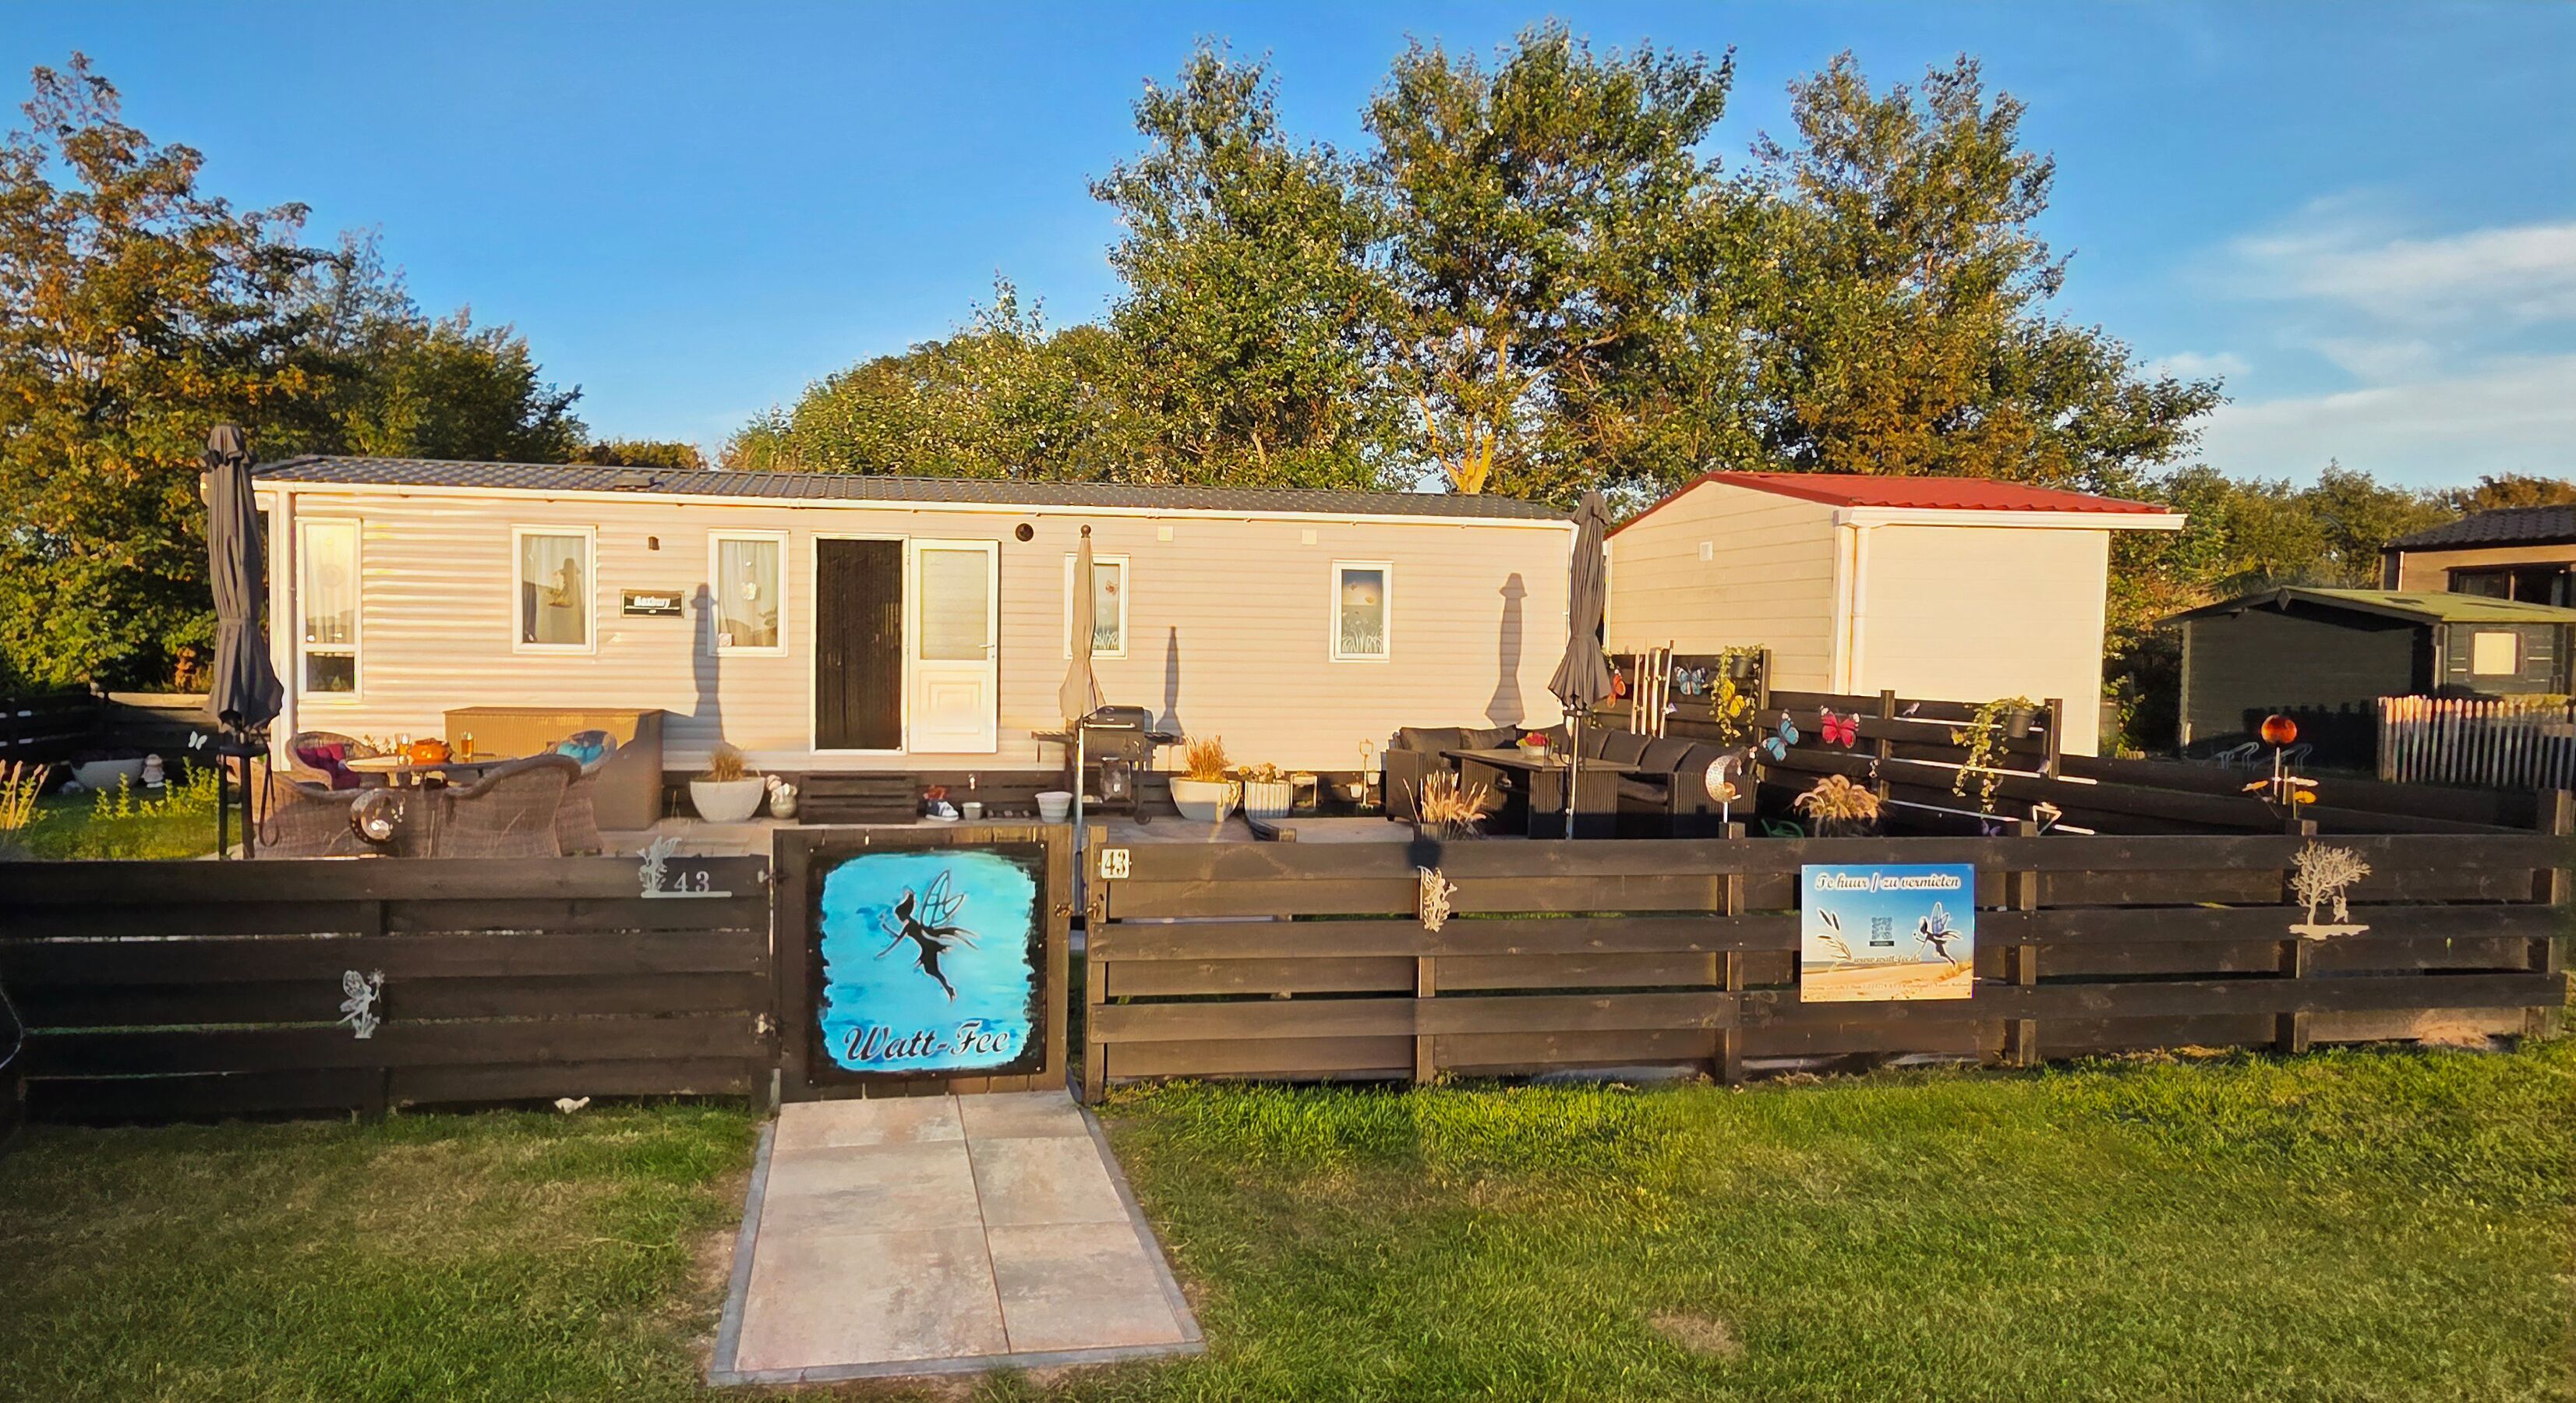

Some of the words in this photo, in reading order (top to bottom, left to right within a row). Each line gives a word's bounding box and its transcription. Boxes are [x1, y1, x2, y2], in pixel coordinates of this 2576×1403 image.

[1104, 851, 1125, 875] 43
[673, 871, 710, 892] 43
[1816, 875, 1834, 889] Te
[1837, 875, 1867, 888] huur
[1902, 875, 1959, 887] vermieten
